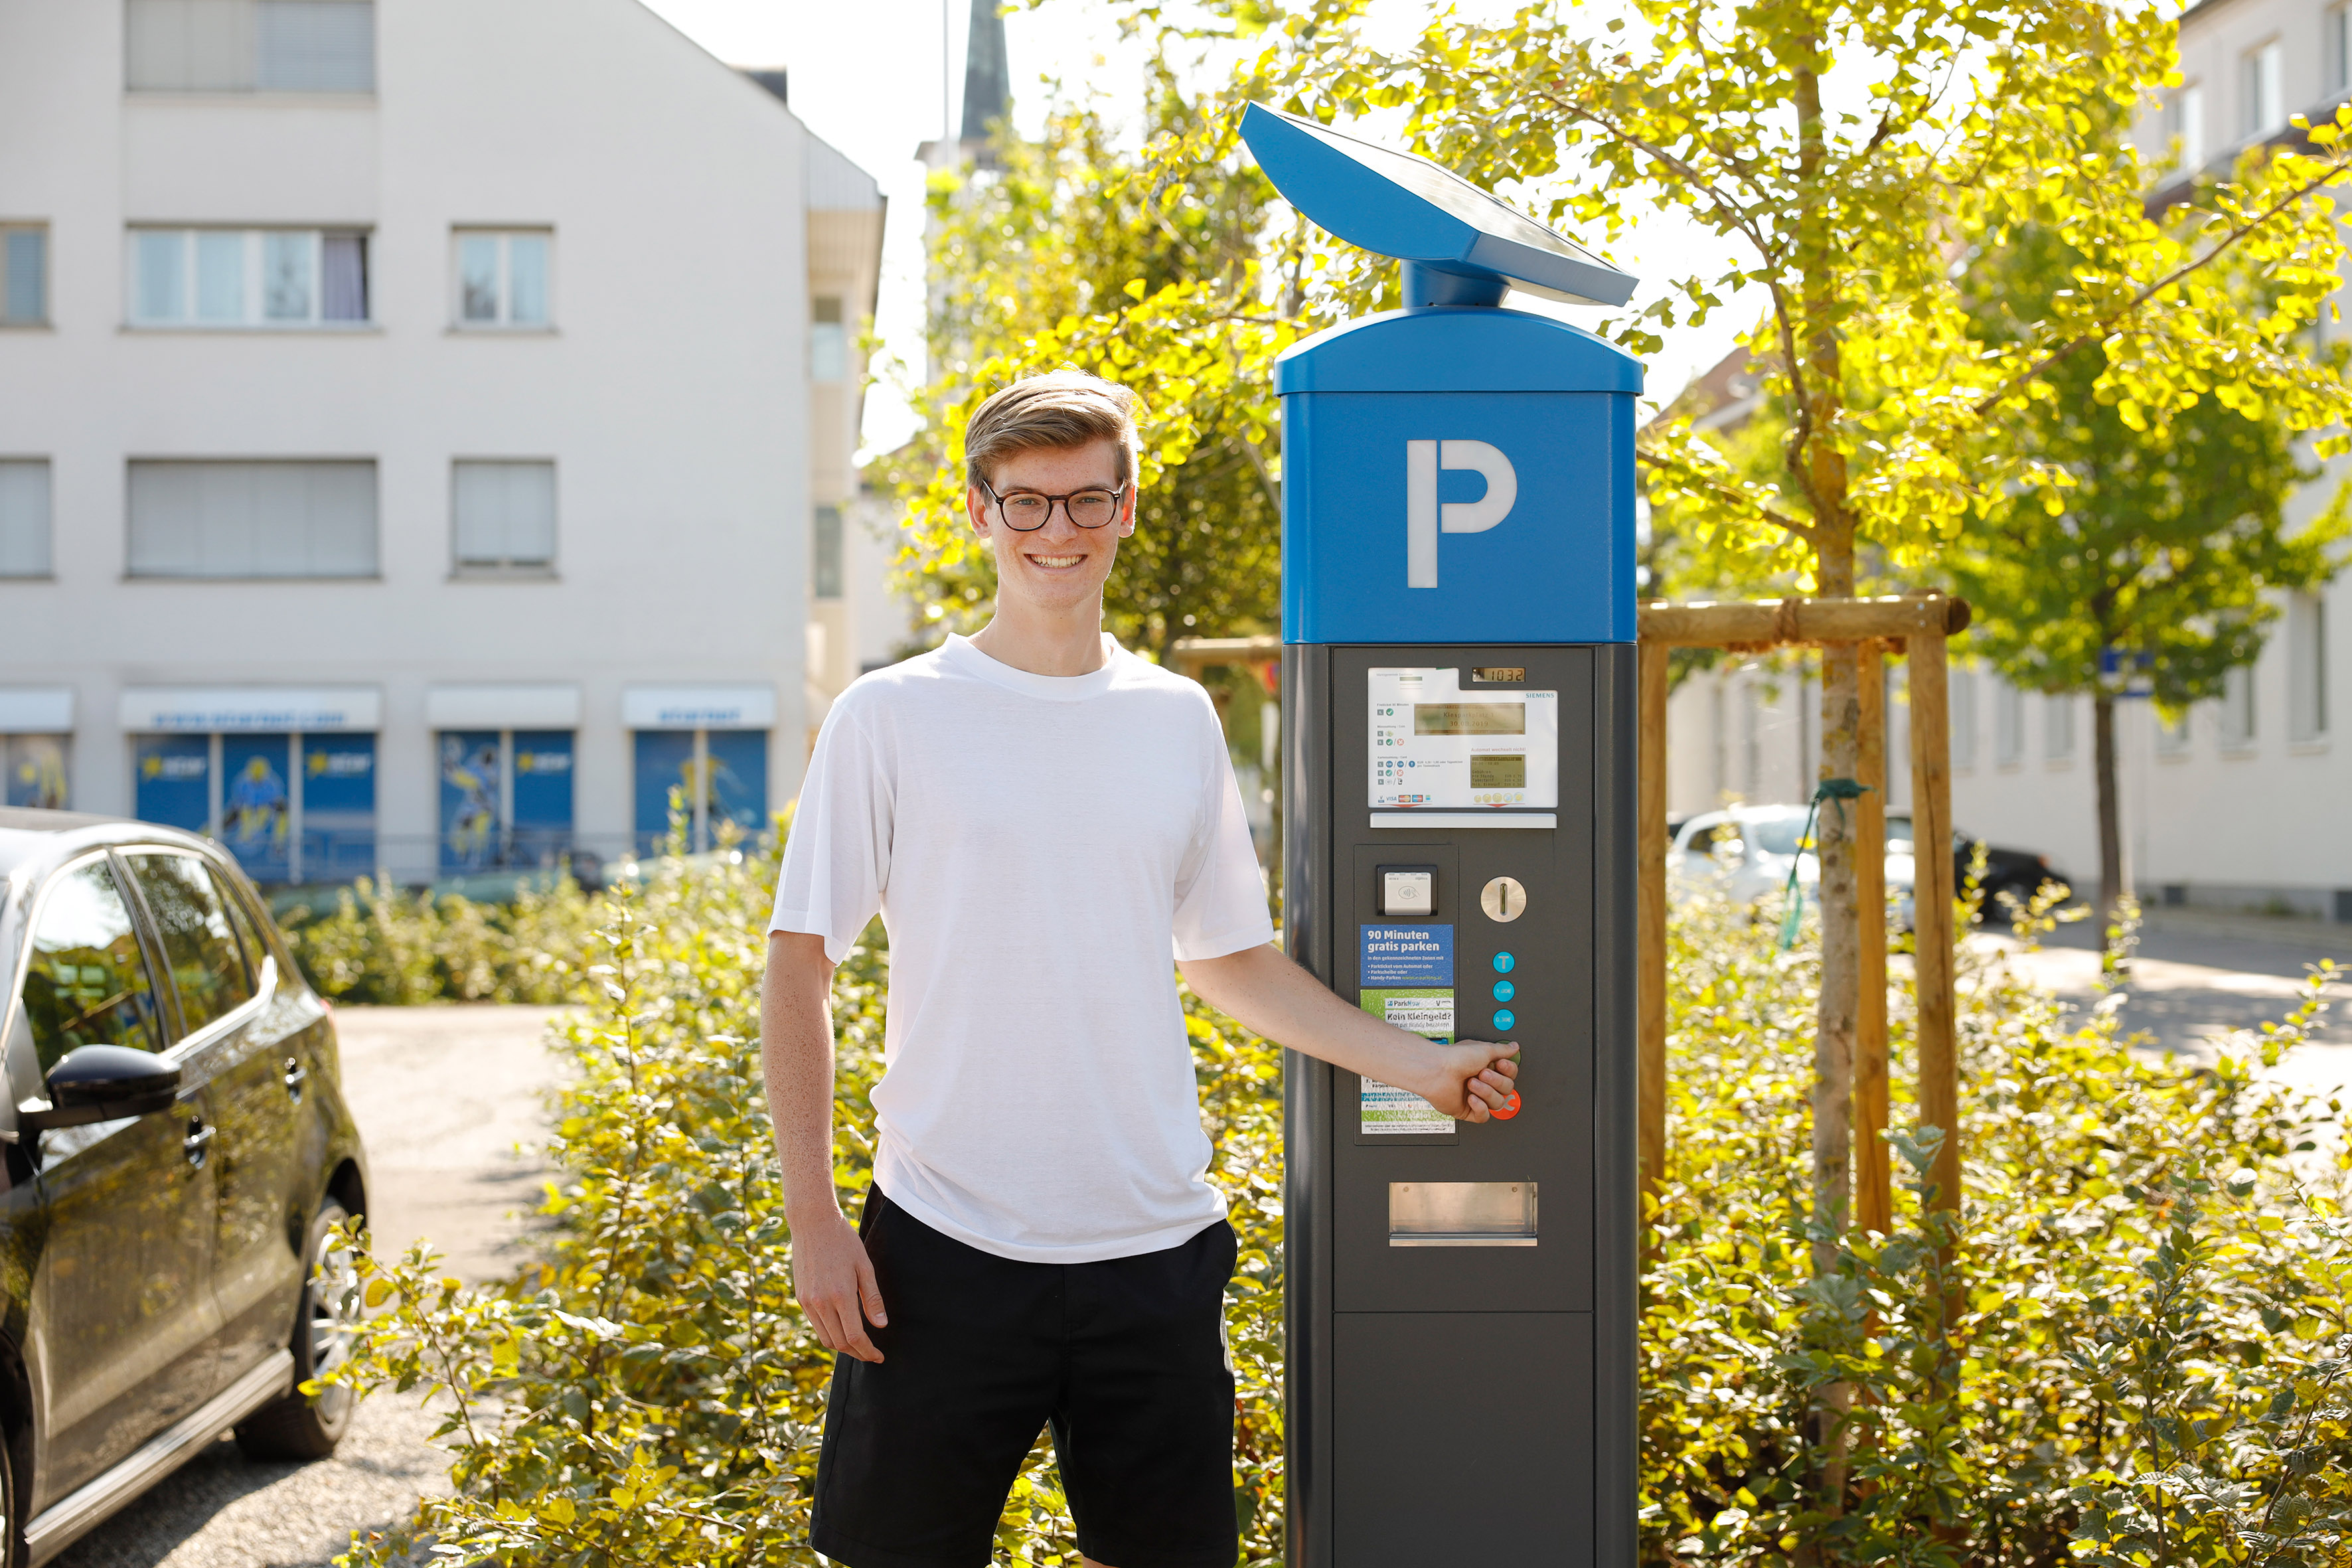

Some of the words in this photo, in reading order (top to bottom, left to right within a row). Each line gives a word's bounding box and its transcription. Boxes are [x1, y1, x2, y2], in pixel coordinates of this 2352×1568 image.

[1407, 439, 1518, 588] P
[1368, 930, 1381, 940] 90
[1384, 929, 1429, 940] Minuten
[1368, 941, 1399, 953] gratis
[1401, 941, 1440, 953] parken
[1498, 955, 1510, 969] T
[1407, 1012, 1451, 1022] Kleingeld?
